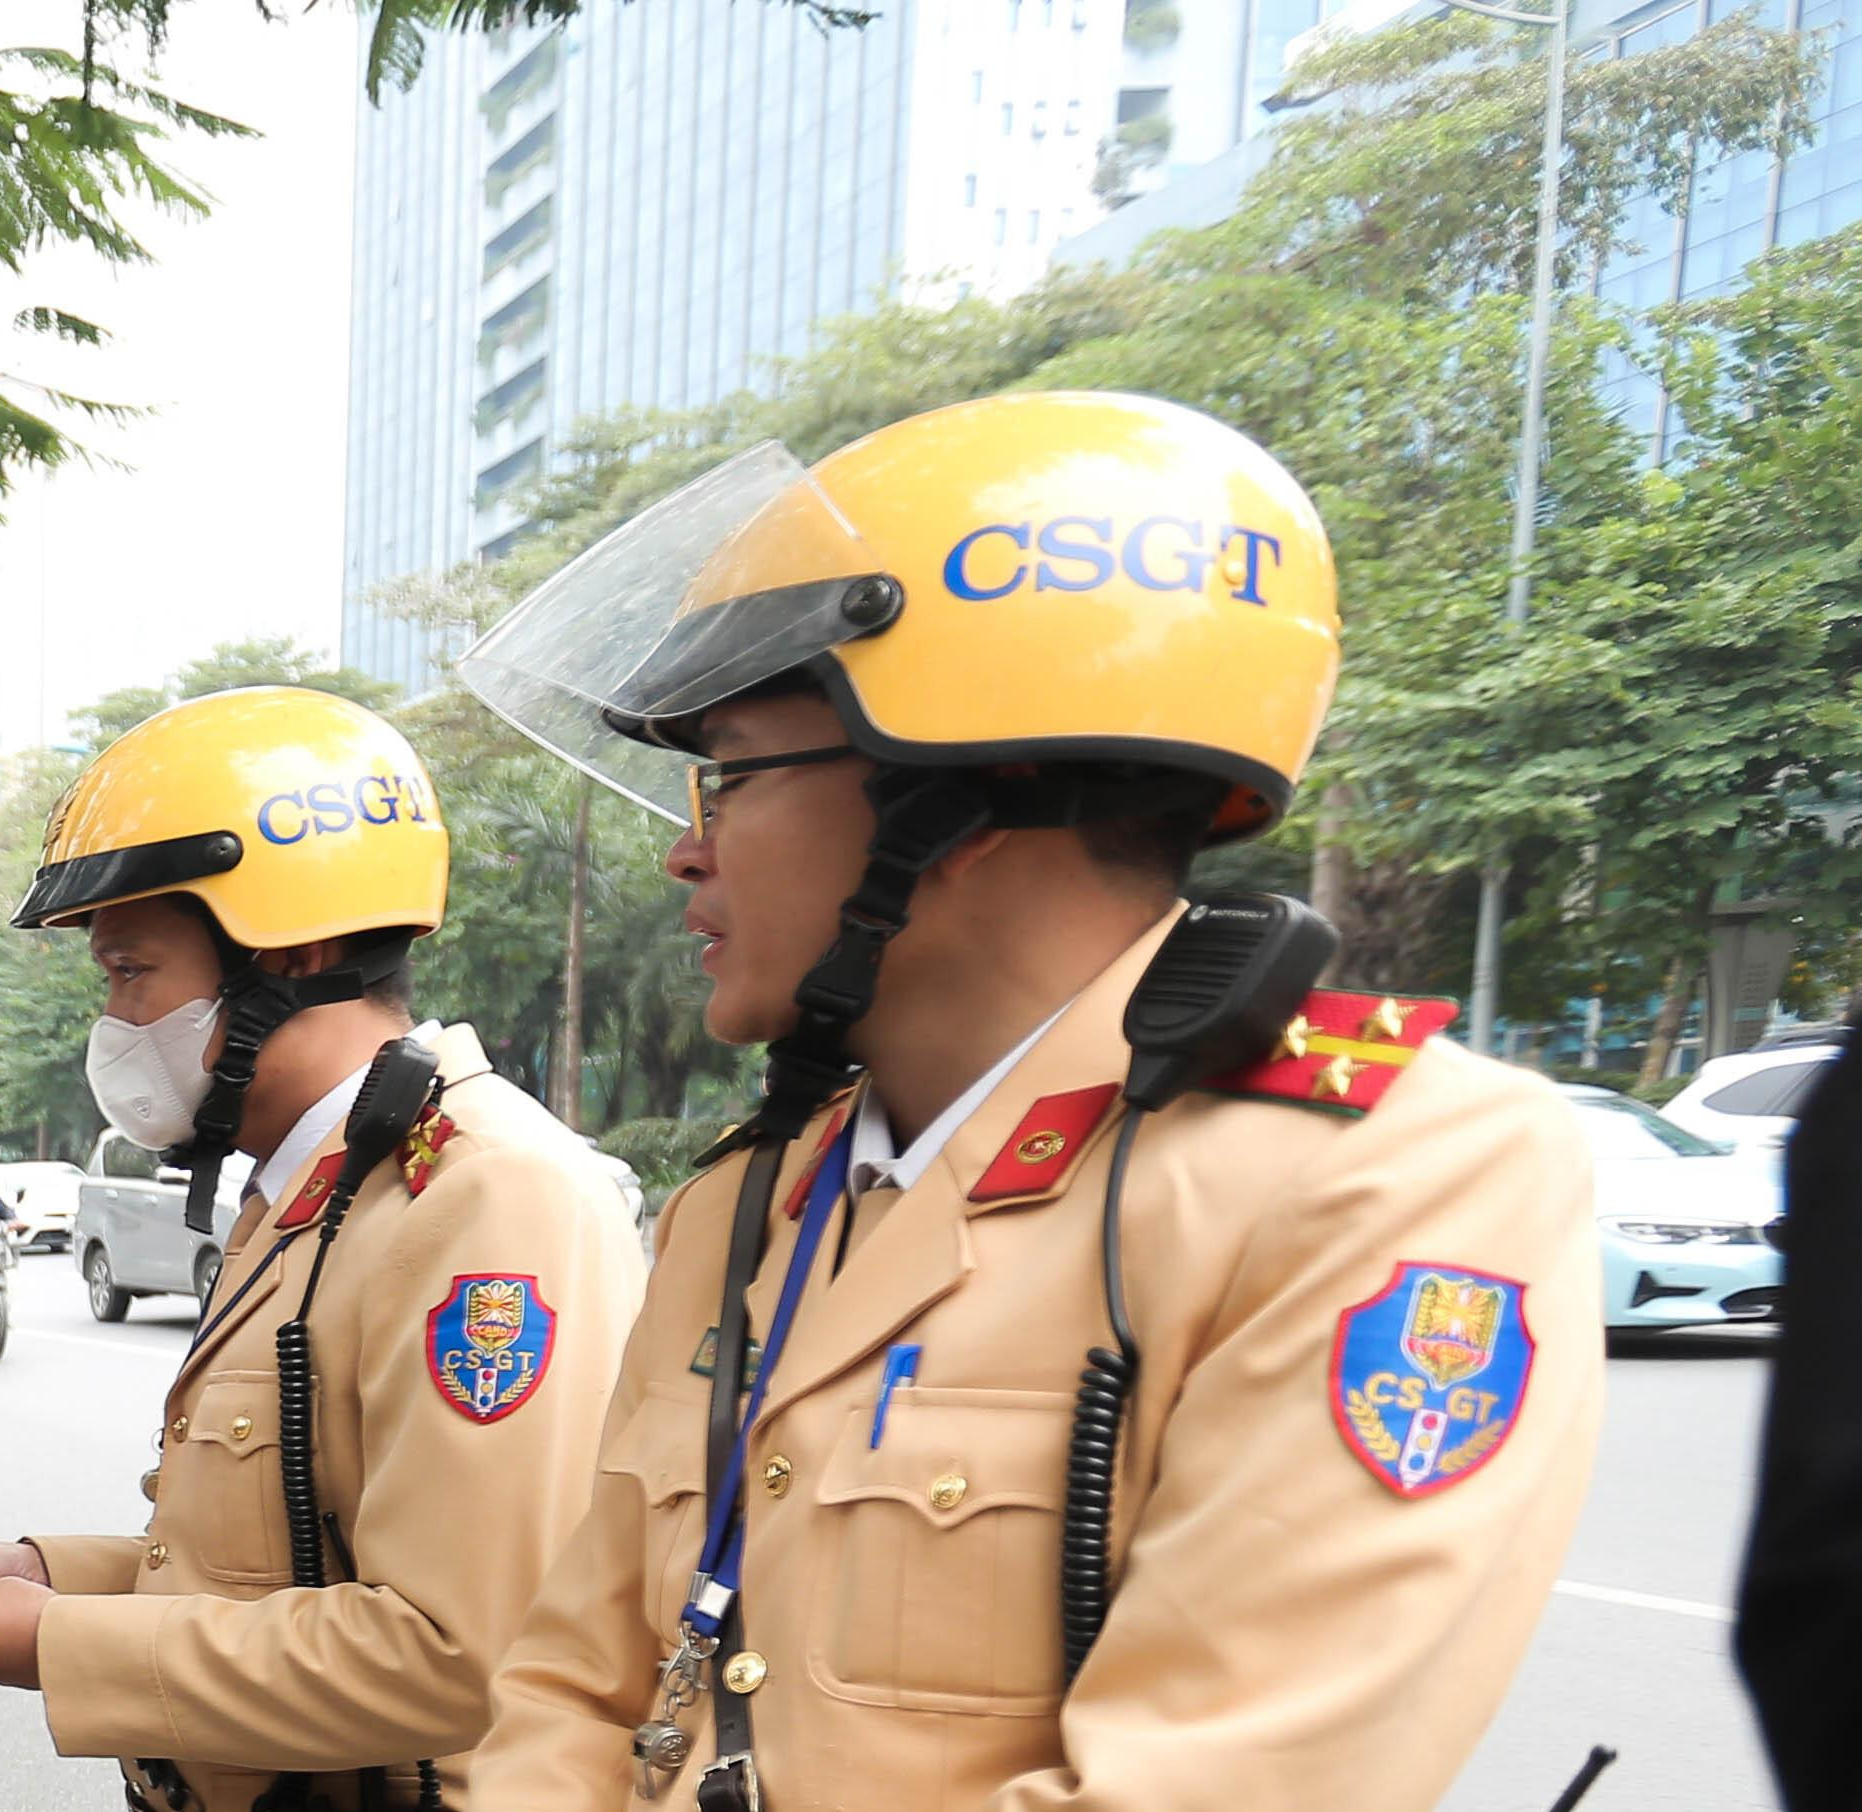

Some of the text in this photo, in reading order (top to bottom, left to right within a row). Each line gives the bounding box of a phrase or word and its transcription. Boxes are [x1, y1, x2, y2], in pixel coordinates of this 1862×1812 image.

[943, 515, 1281, 607] CSGT
[257, 773, 428, 847] CSGT
[444, 1349, 535, 1371] CS GT
[1364, 1371, 1500, 1425] CS GT
